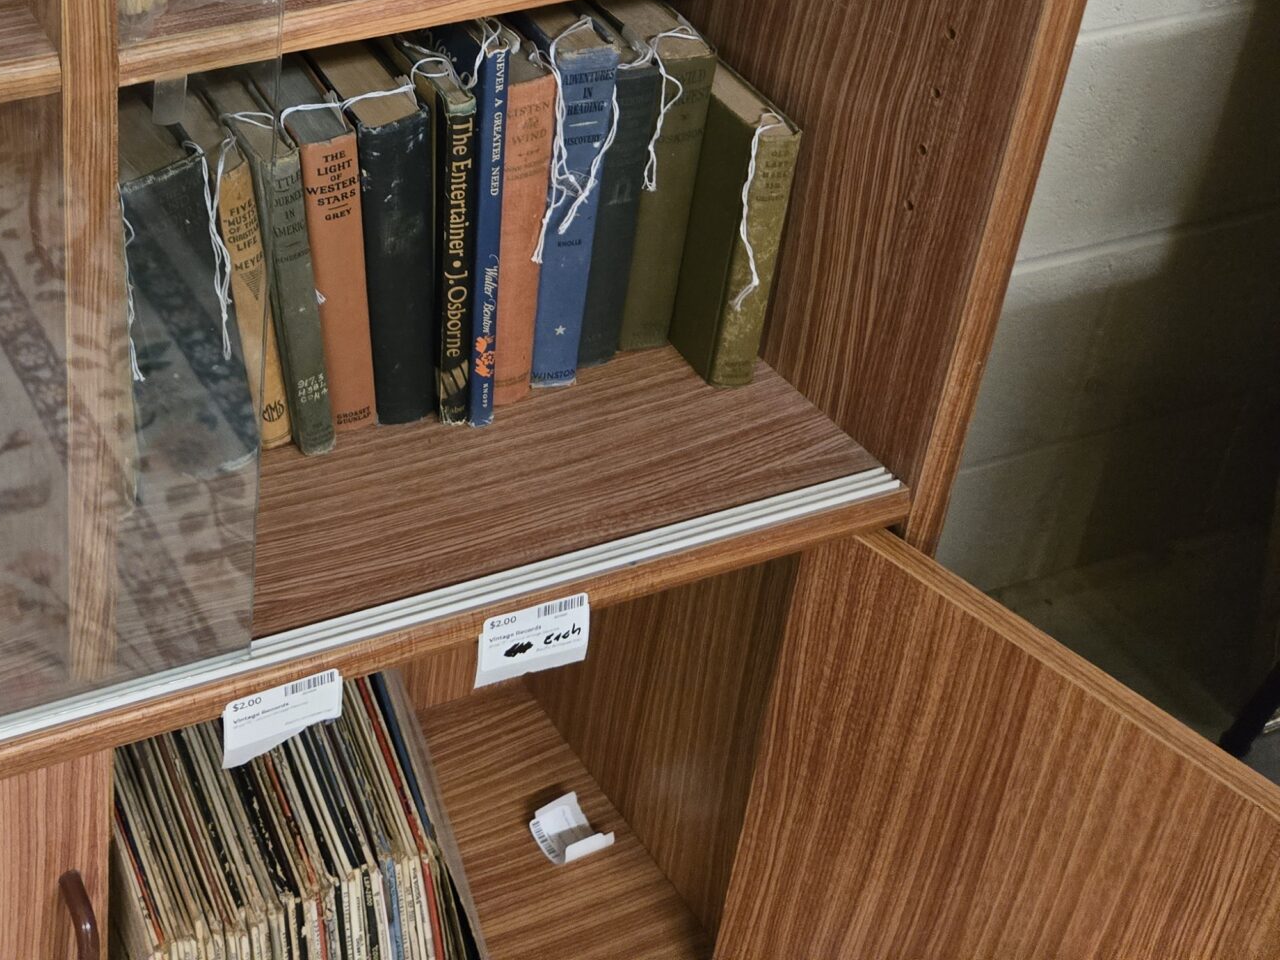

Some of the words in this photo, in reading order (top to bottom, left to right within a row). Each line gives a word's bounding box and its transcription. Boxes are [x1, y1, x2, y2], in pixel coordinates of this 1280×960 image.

[495, 52, 505, 93] NEVER
[562, 68, 615, 85] ADVENTURES
[583, 87, 593, 99] IN
[494, 98, 504, 108] A
[508, 99, 551, 120] LISTEN
[567, 100, 605, 116] READING
[452, 118, 473, 156] The
[492, 112, 503, 163] GREATER
[512, 128, 547, 144] WIND
[323, 150, 346, 163] THE
[317, 159, 352, 177] LIGHT
[330, 172, 342, 182] OF
[490, 167, 500, 197] NEED
[317, 188, 356, 206] STARS
[229, 198, 253, 217] FIVE
[284, 208, 295, 220] IN
[325, 208, 352, 221] GREY
[448, 158, 472, 257] Entertainer
[228, 226, 240, 235] OF
[236, 235, 258, 252] LIFE
[483, 254, 499, 299] Walter
[446, 286, 468, 358] Osborne
[482, 299, 497, 335] Benton
[297, 373, 324, 388] 917.3
[532, 368, 576, 380] WINSTON
[490, 616, 517, 630] $2.00
[489, 632, 514, 643] Vintage
[515, 625, 542, 636] Records
[232, 696, 262, 712] $2.00
[233, 712, 260, 725] Vintage
